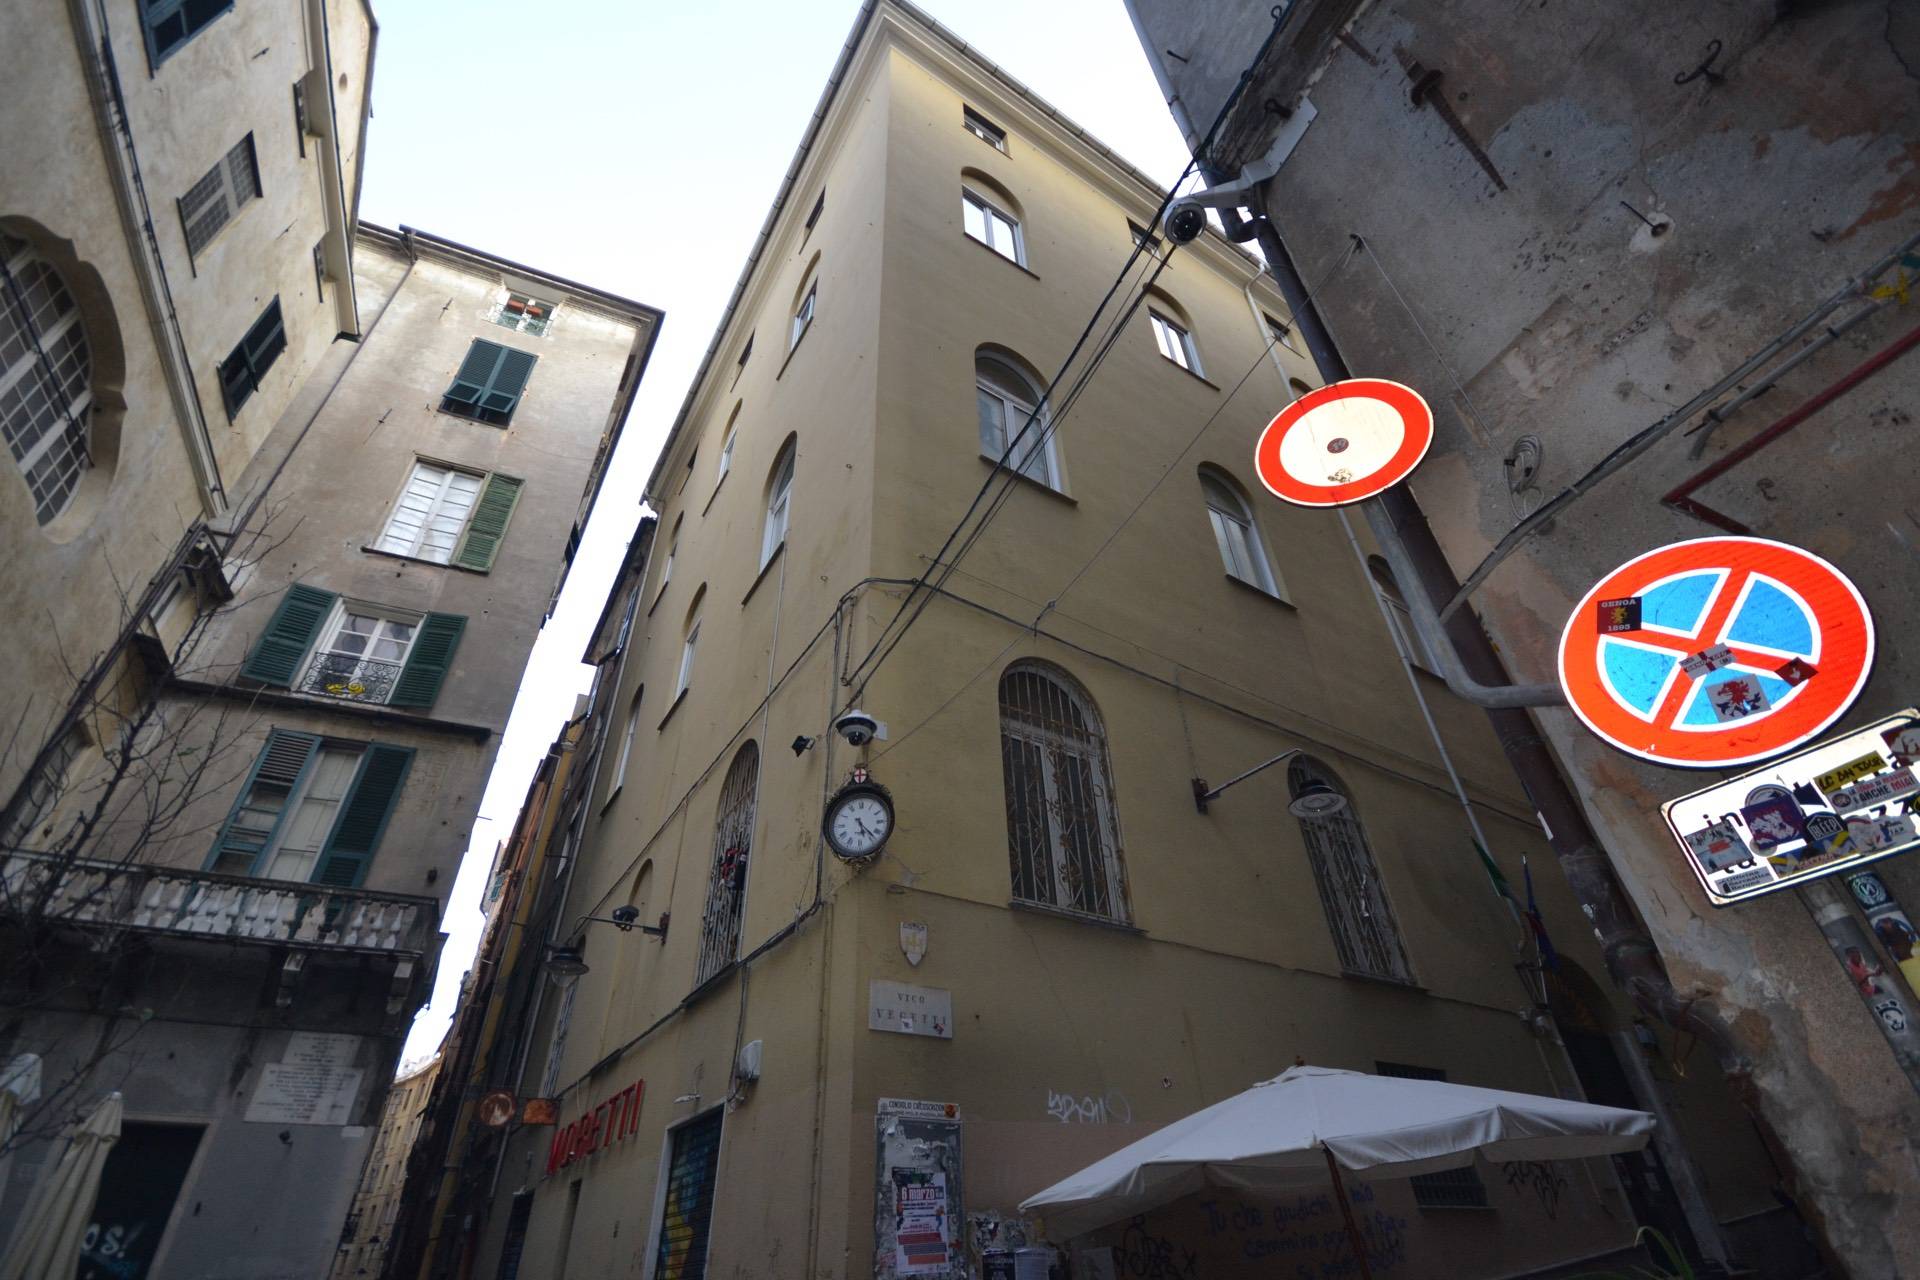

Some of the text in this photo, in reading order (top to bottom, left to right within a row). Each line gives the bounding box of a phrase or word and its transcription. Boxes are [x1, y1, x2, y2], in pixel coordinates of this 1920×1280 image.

[1601, 599, 1636, 608] GENOA
[897, 992, 926, 1004] VICO
[546, 1078, 645, 1175] MORETTI
[901, 1187, 907, 1200] 6
[909, 1188, 935, 1200] marzo
